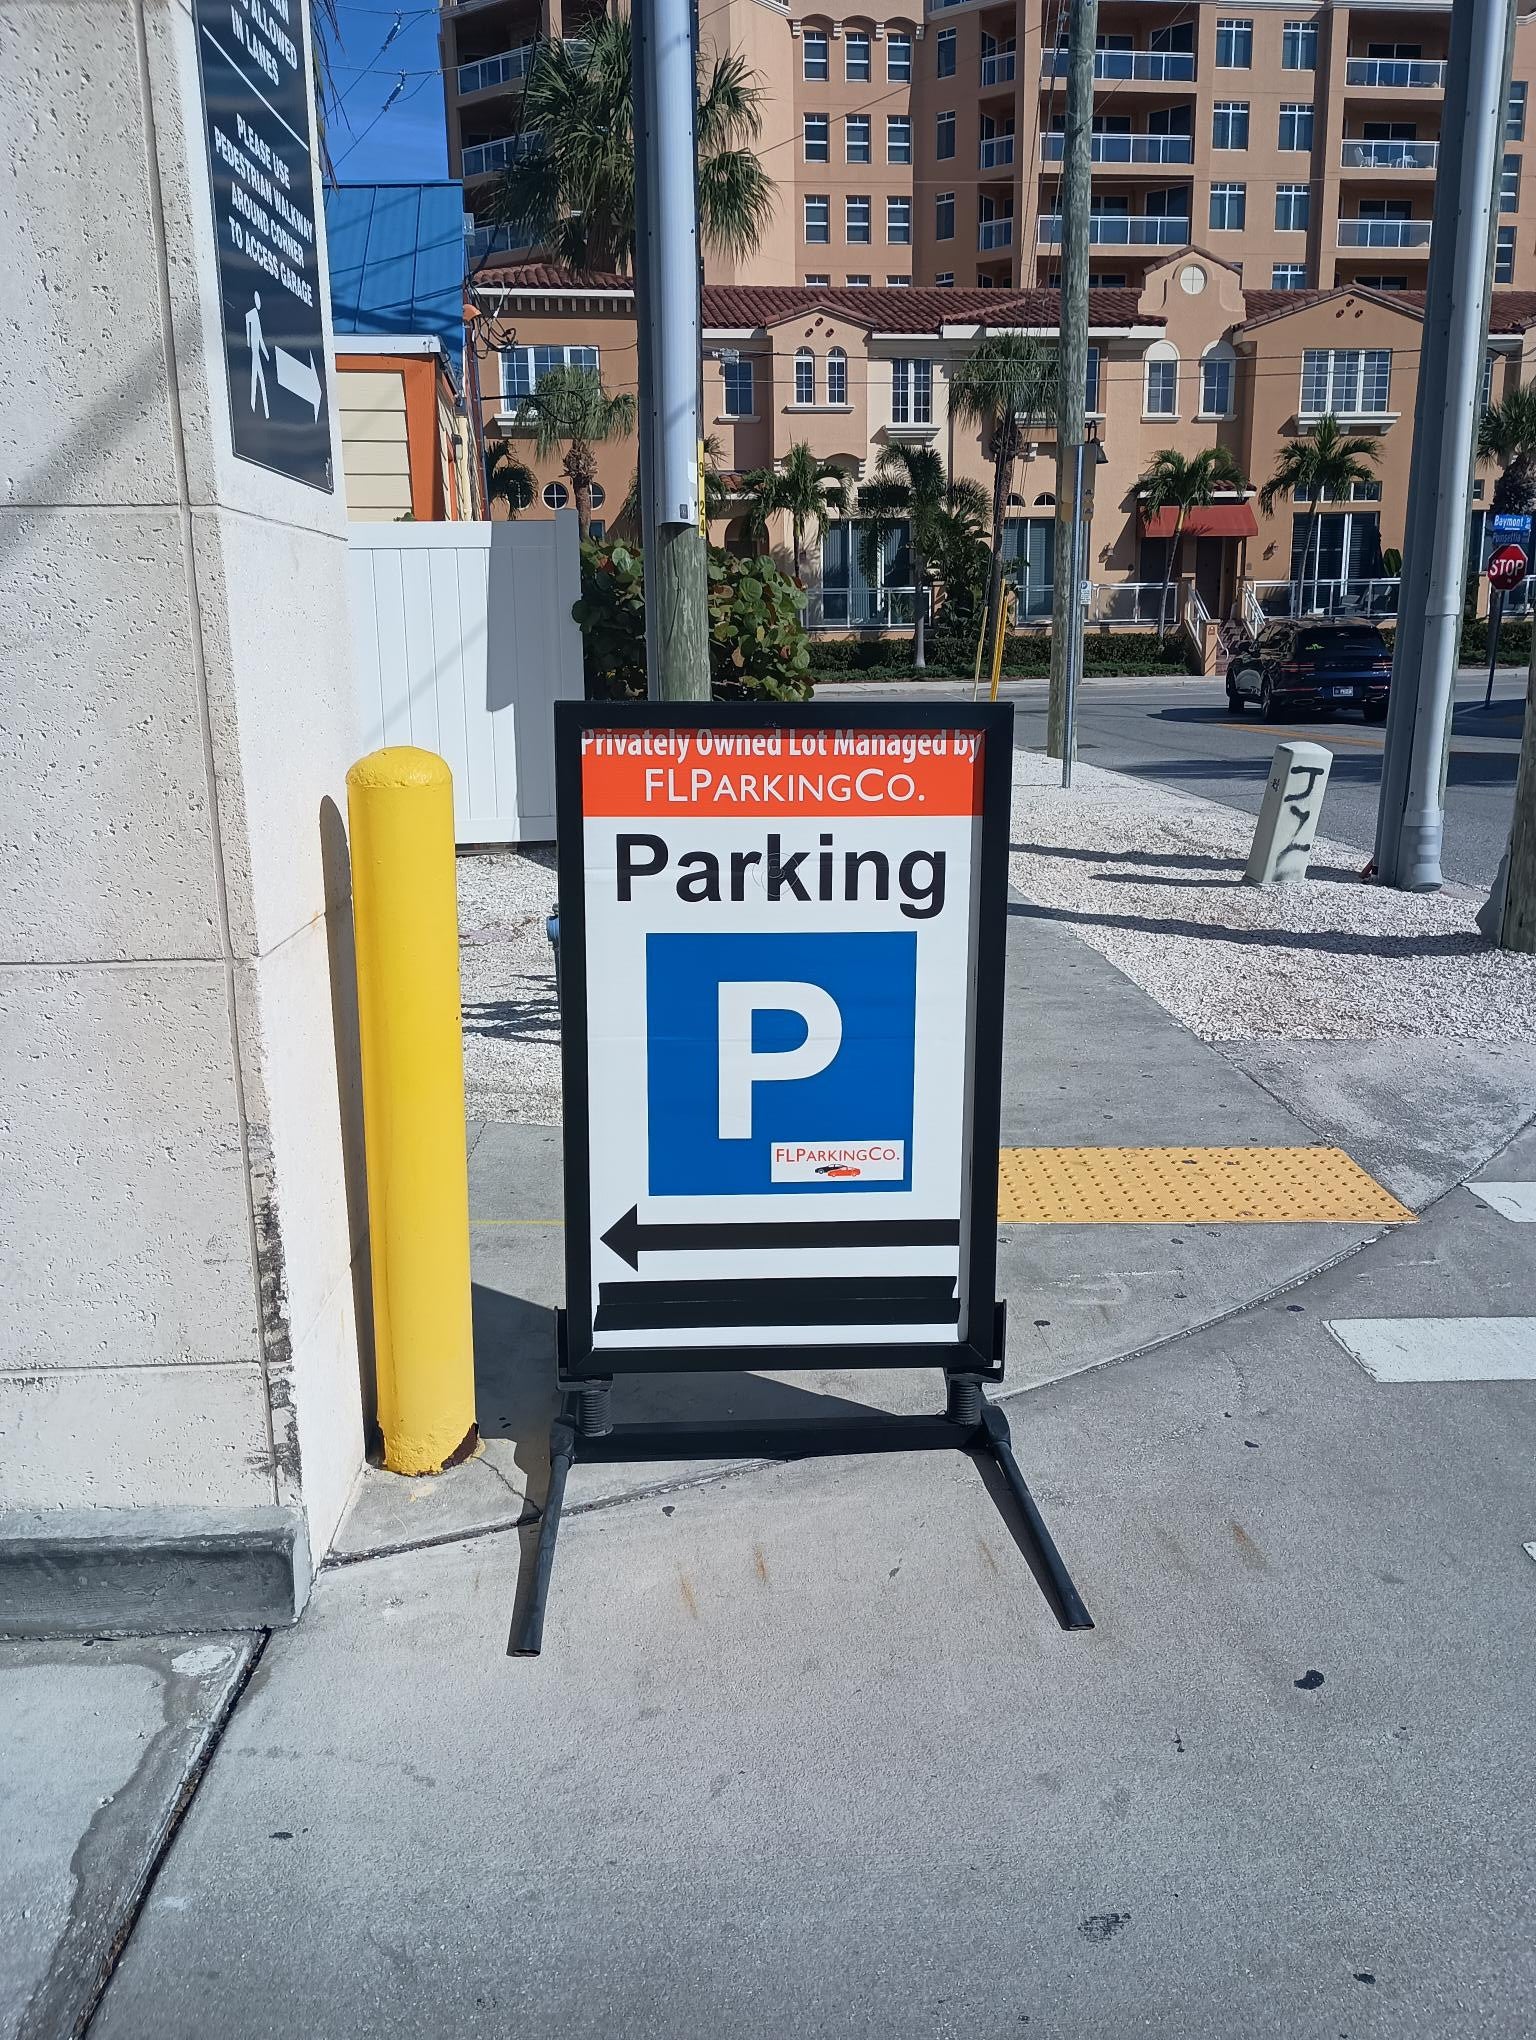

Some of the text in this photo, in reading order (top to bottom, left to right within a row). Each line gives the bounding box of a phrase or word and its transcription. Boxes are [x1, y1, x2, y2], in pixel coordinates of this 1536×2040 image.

[231, 4, 245, 45] IN
[245, 22, 280, 86] LANES
[251, 0, 299, 70] ALLOWED
[214, 125, 313, 243] PEDESTRIAN WALKWAY
[236, 112, 291, 190] PLEASE USE
[228, 215, 313, 308] TO ACCESS GARAGE
[232, 181, 305, 268] AROUND CORNER
[1493, 514, 1524, 528] Baymont
[1489, 559, 1525, 576] STOP
[581, 728, 982, 764] Privately Owned Lot Managed by
[616, 833, 946, 920] Parking
[718, 981, 842, 1139] P
